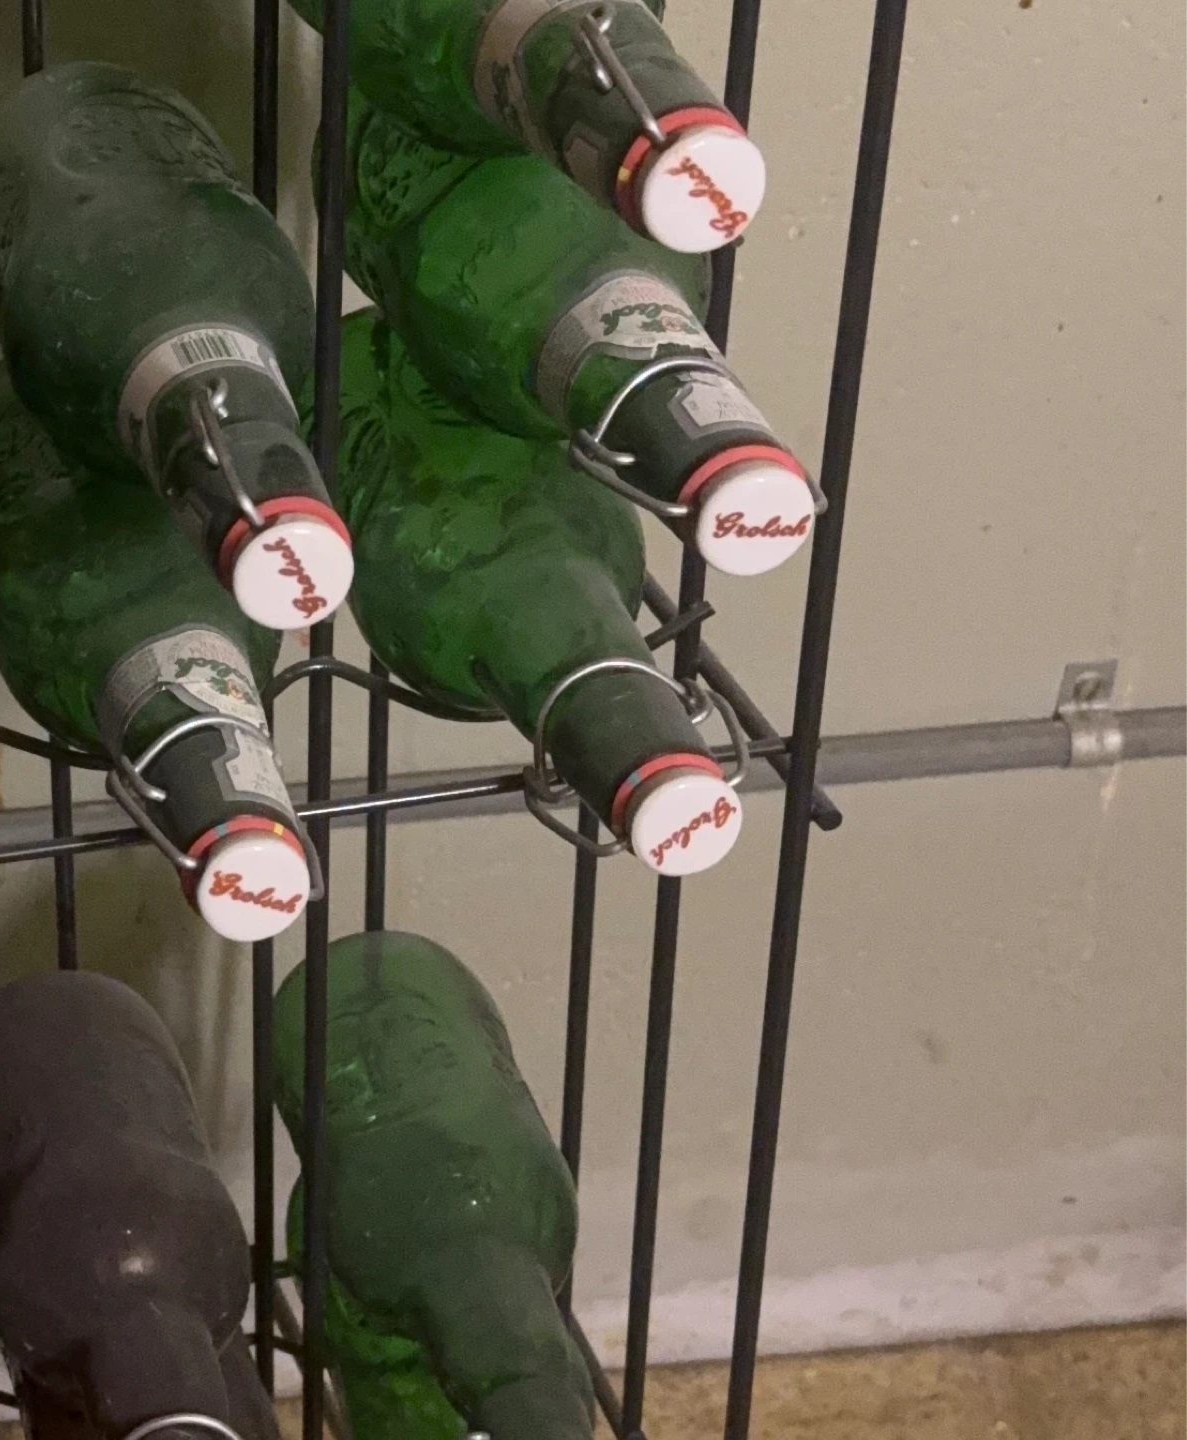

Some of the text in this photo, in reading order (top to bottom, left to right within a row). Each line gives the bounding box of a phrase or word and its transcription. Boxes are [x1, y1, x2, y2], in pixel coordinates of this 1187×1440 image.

[666, 156, 748, 240] Grolsch
[712, 511, 811, 539] Grolsch
[262, 537, 328, 619] Grolsch
[649, 796, 737, 867] Grolsch
[208, 870, 303, 914] Grolsch
